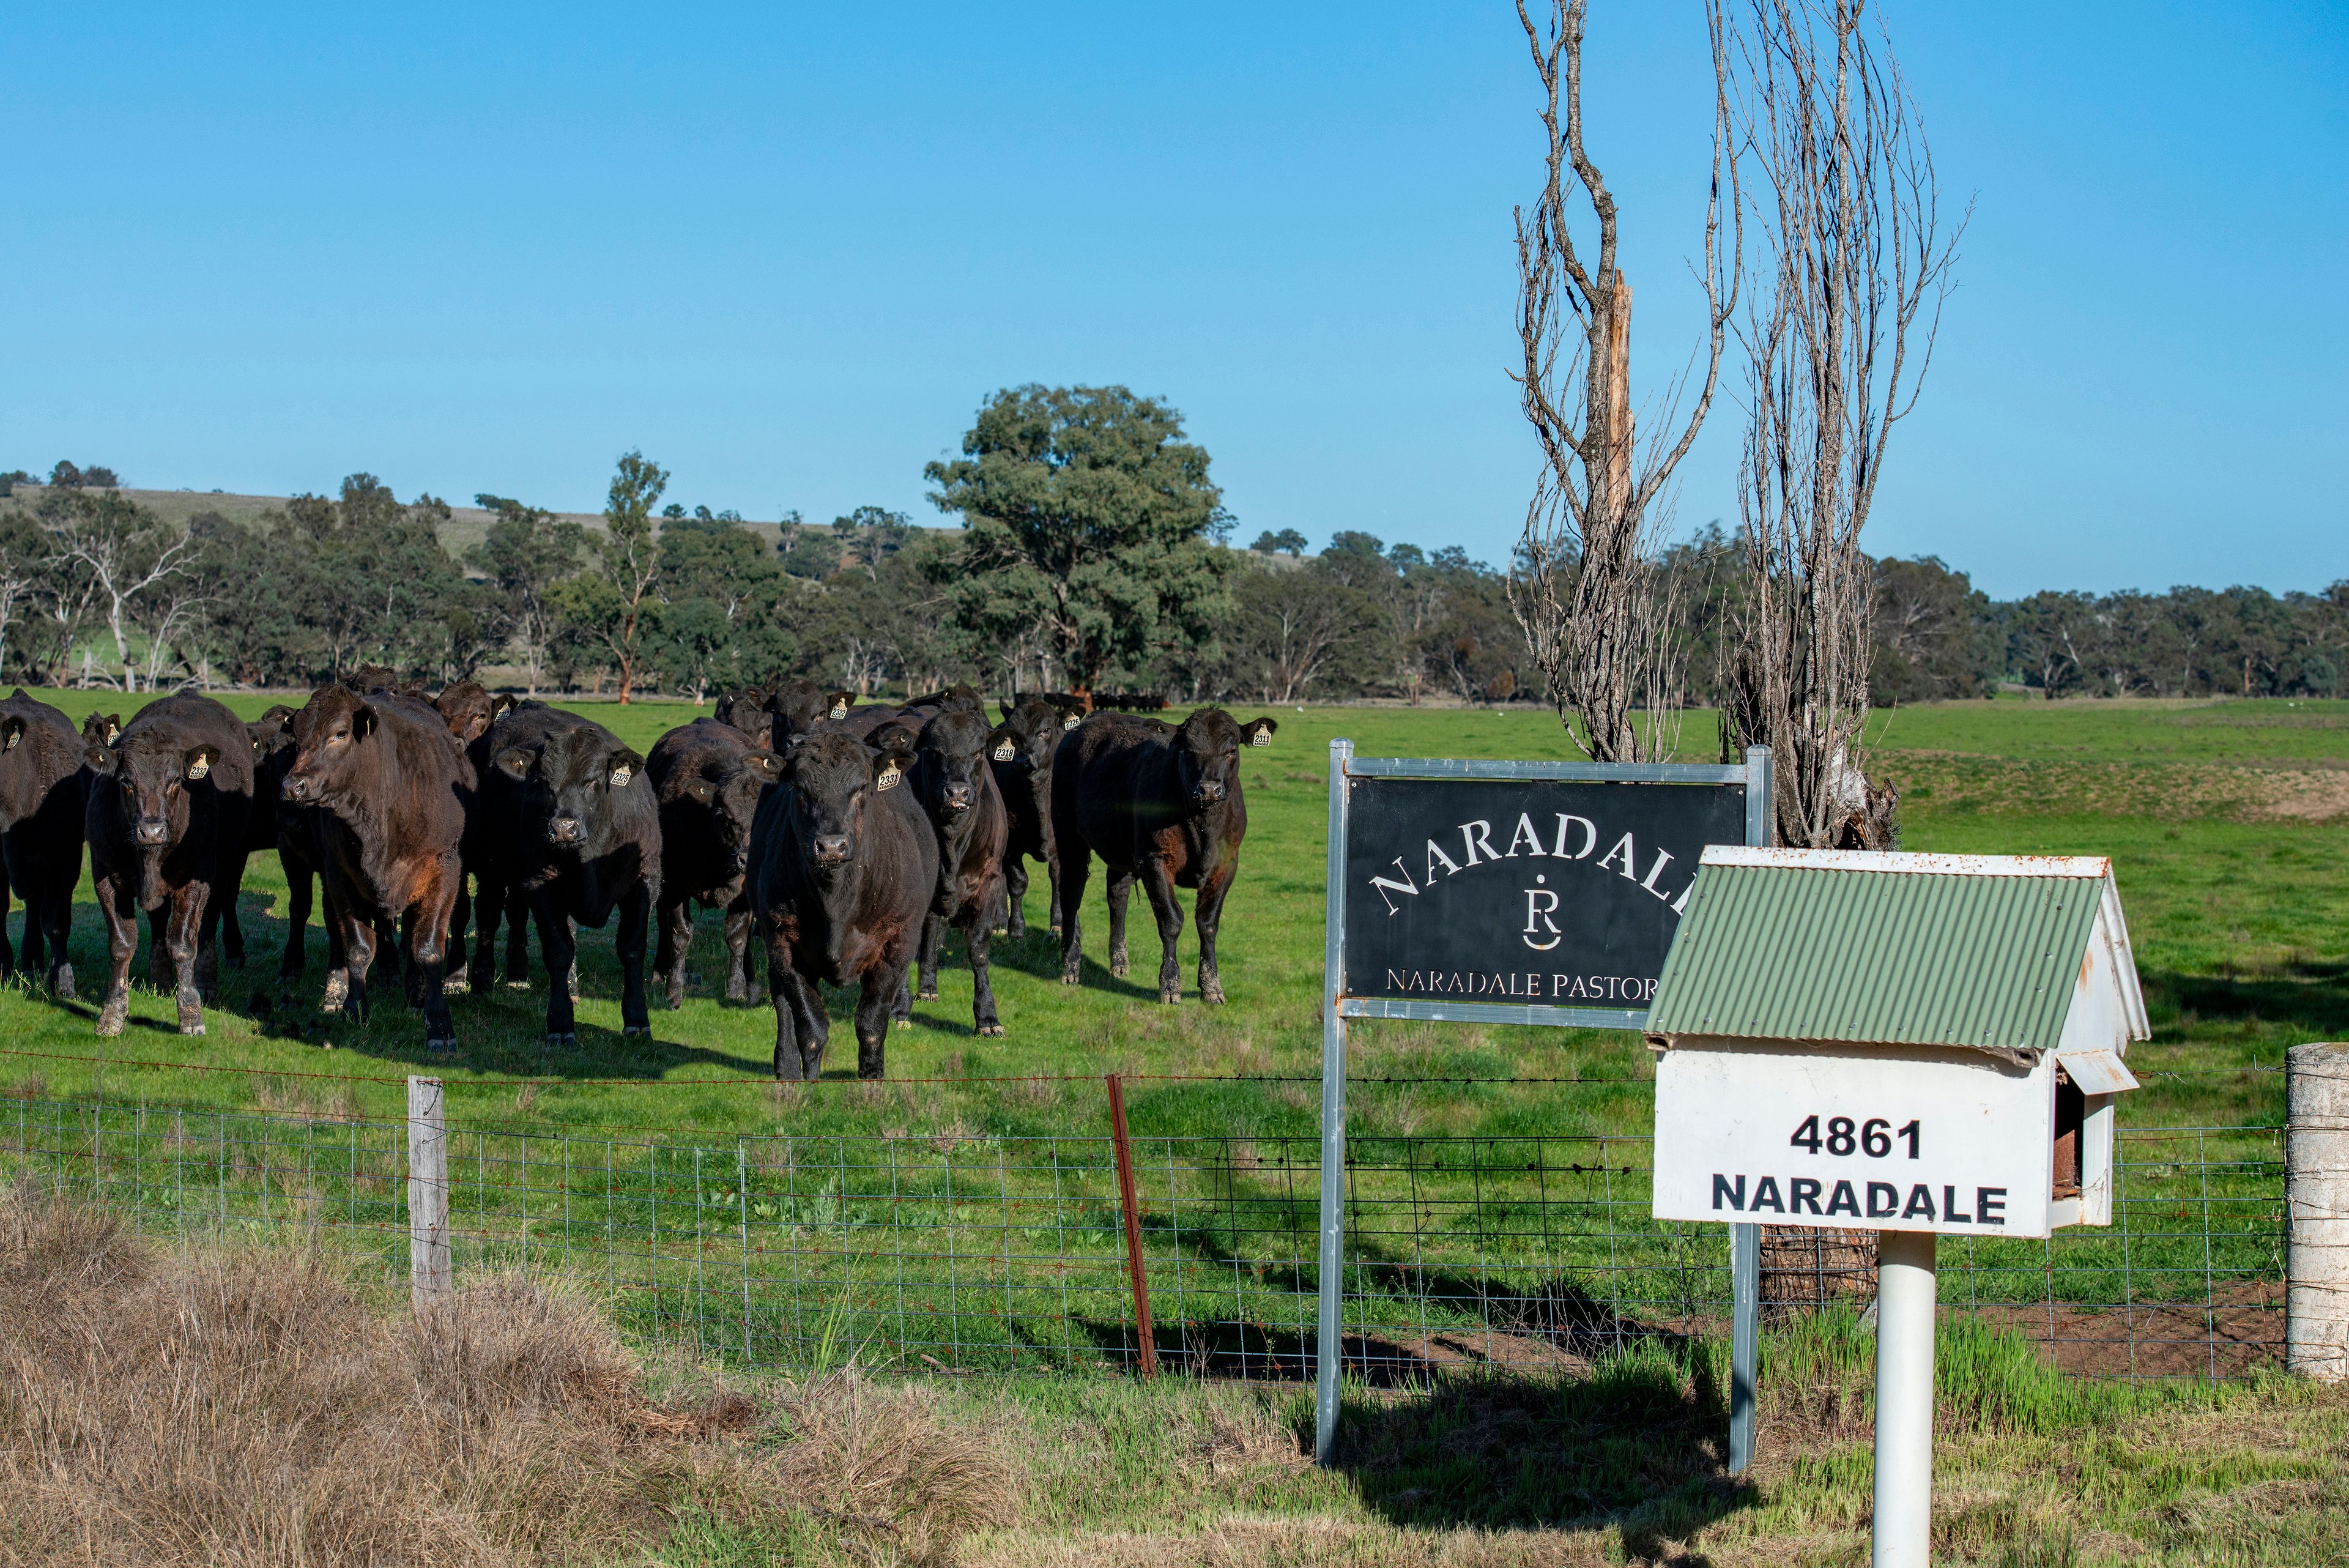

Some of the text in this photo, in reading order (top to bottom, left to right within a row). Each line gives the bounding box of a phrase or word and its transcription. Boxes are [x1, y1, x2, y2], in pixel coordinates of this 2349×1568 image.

[1066, 718, 1079, 727] 2326
[191, 767, 207, 775] 2332
[614, 772, 629, 782] 2325
[880, 773, 899, 786] 2331
[1386, 967, 1541, 996] NARADALE
[1790, 1115, 1920, 1159] 4861
[1712, 1173, 2008, 1225] NARADALE
